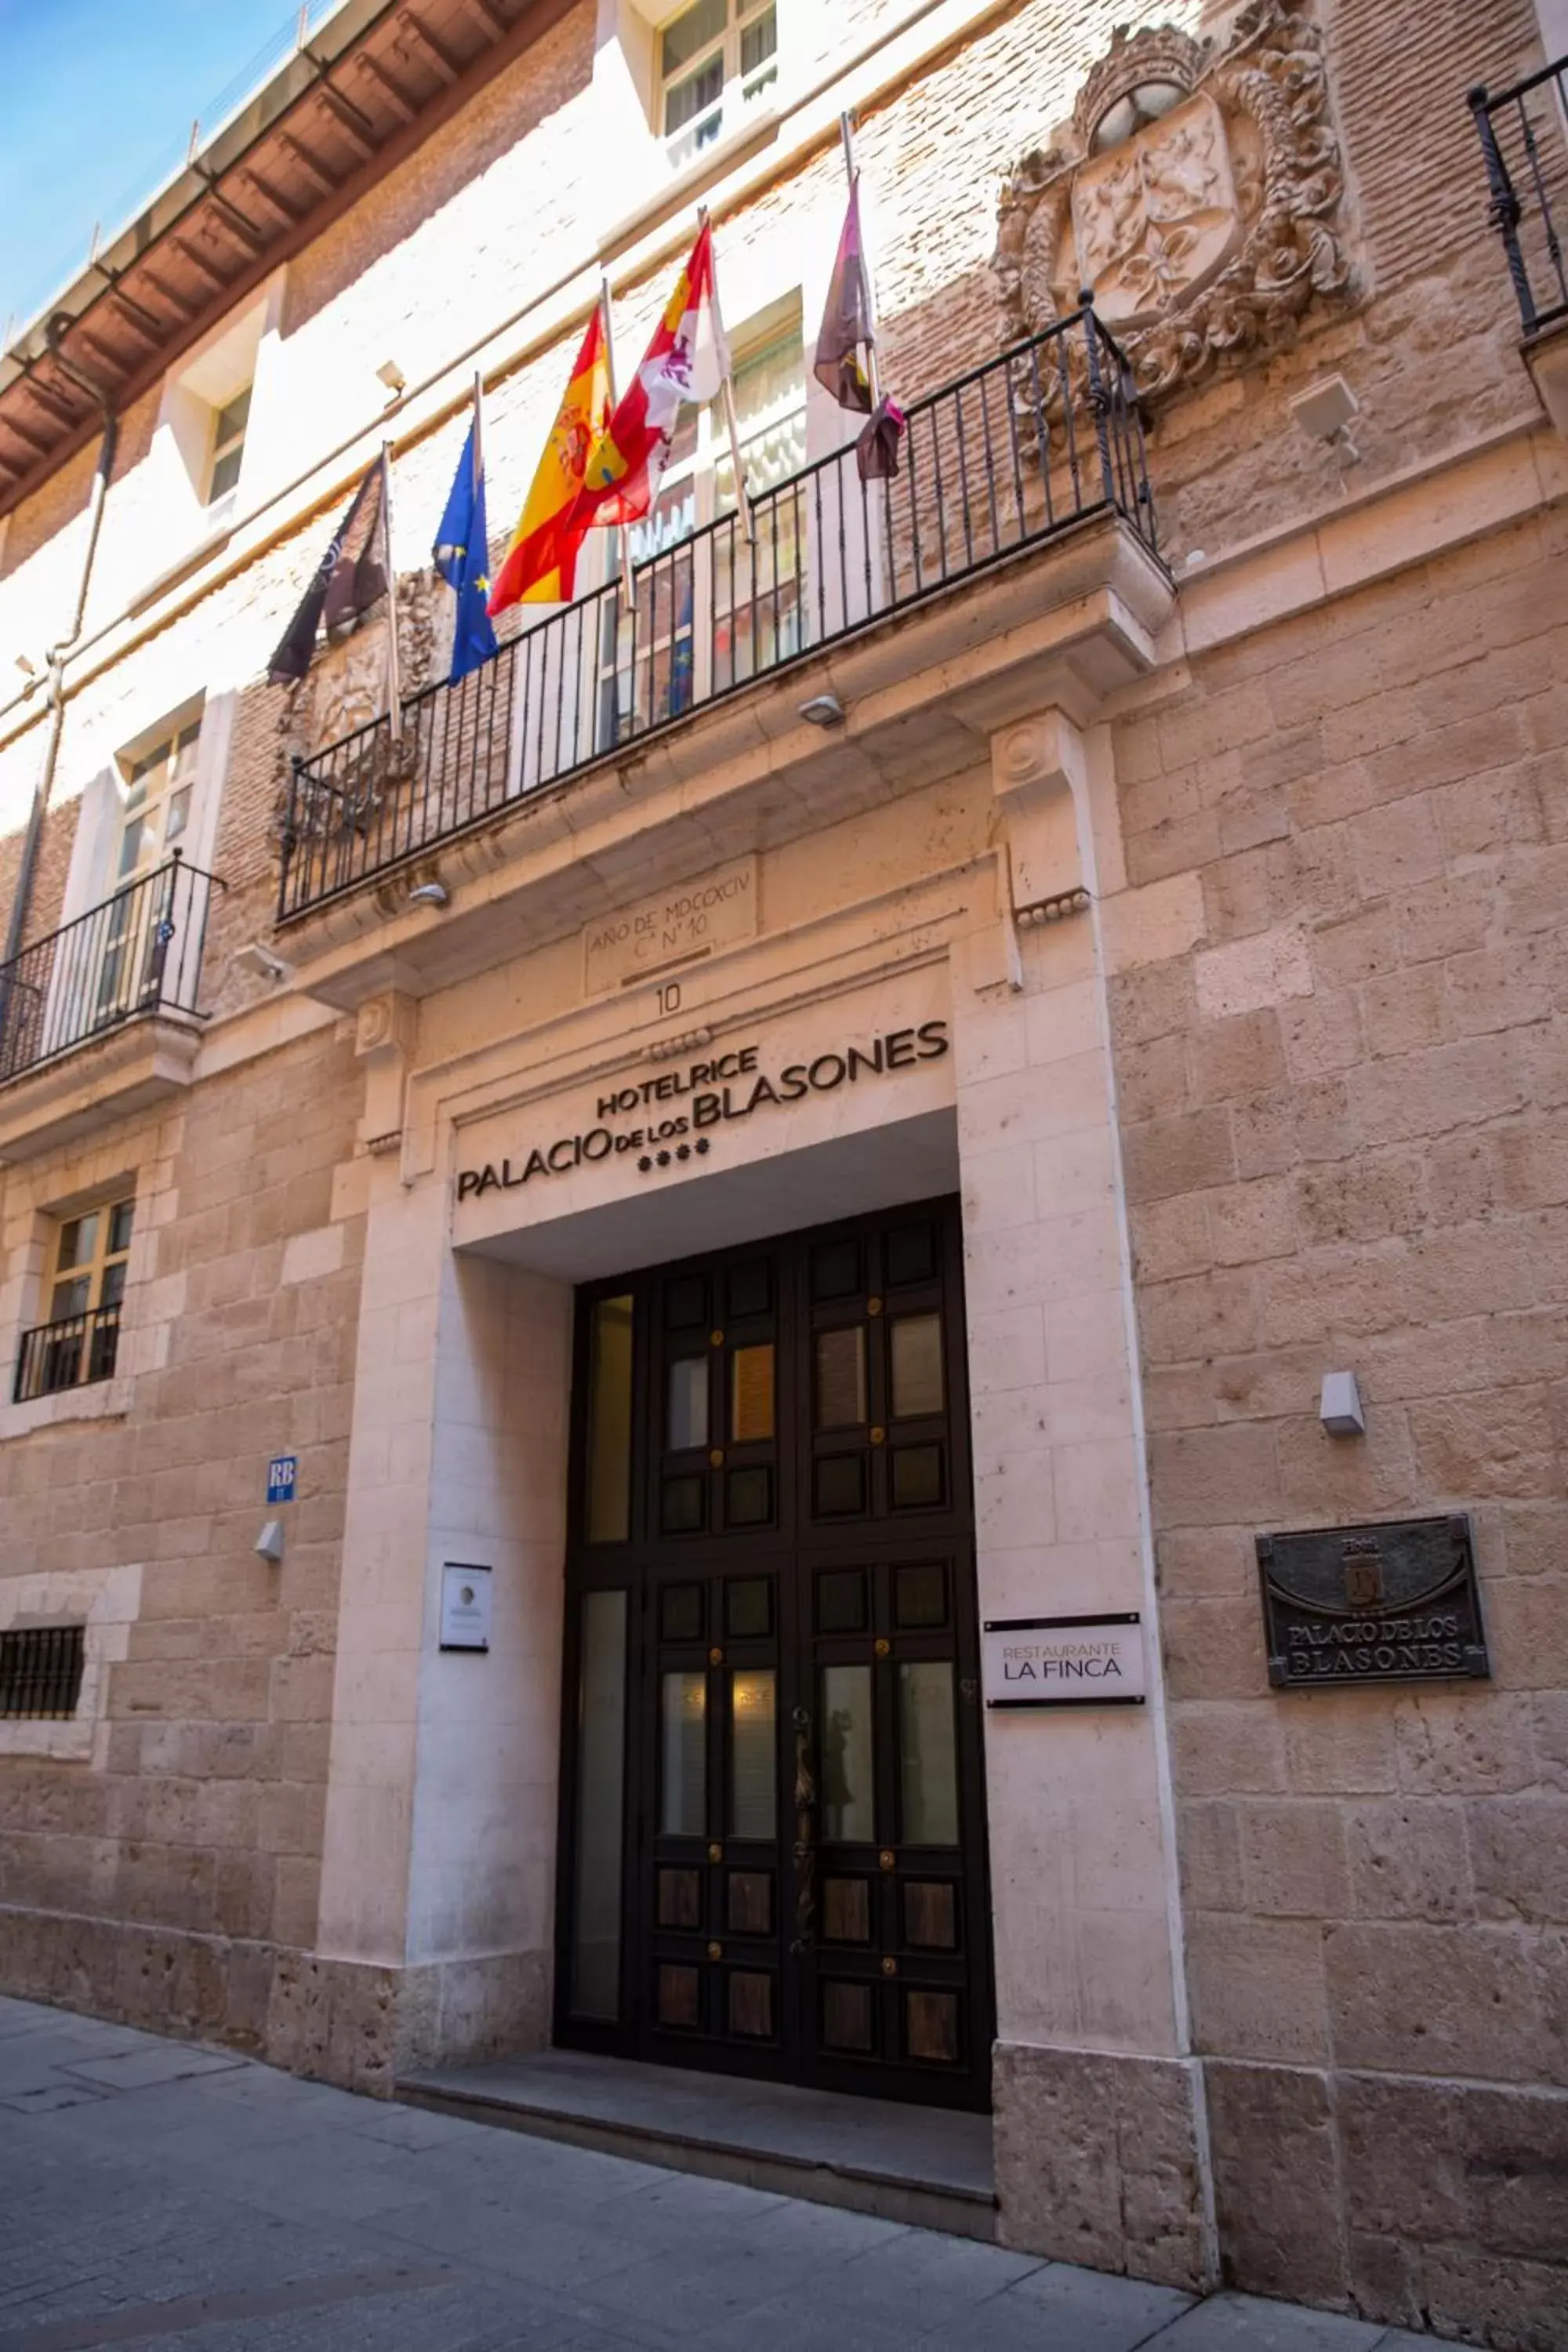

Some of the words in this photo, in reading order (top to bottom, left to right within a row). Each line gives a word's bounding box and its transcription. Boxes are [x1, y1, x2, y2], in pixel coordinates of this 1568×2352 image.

[634, 911, 657, 935] DE
[656, 982, 682, 1017] 10
[458, 1127, 612, 1203] PALACIO
[614, 1129, 644, 1153] DE
[648, 1116, 690, 1144] LOS
[692, 1020, 949, 1130] BLASONES
[1287, 1621, 1377, 1646] PALACIO
[1412, 1616, 1459, 1639] LOS
[1003, 1642, 1122, 1661] RESTAURANTE
[1291, 1642, 1462, 1673] BLASONES
[1004, 1661, 1037, 1680] LA
[1042, 1657, 1123, 1679] FINCA
